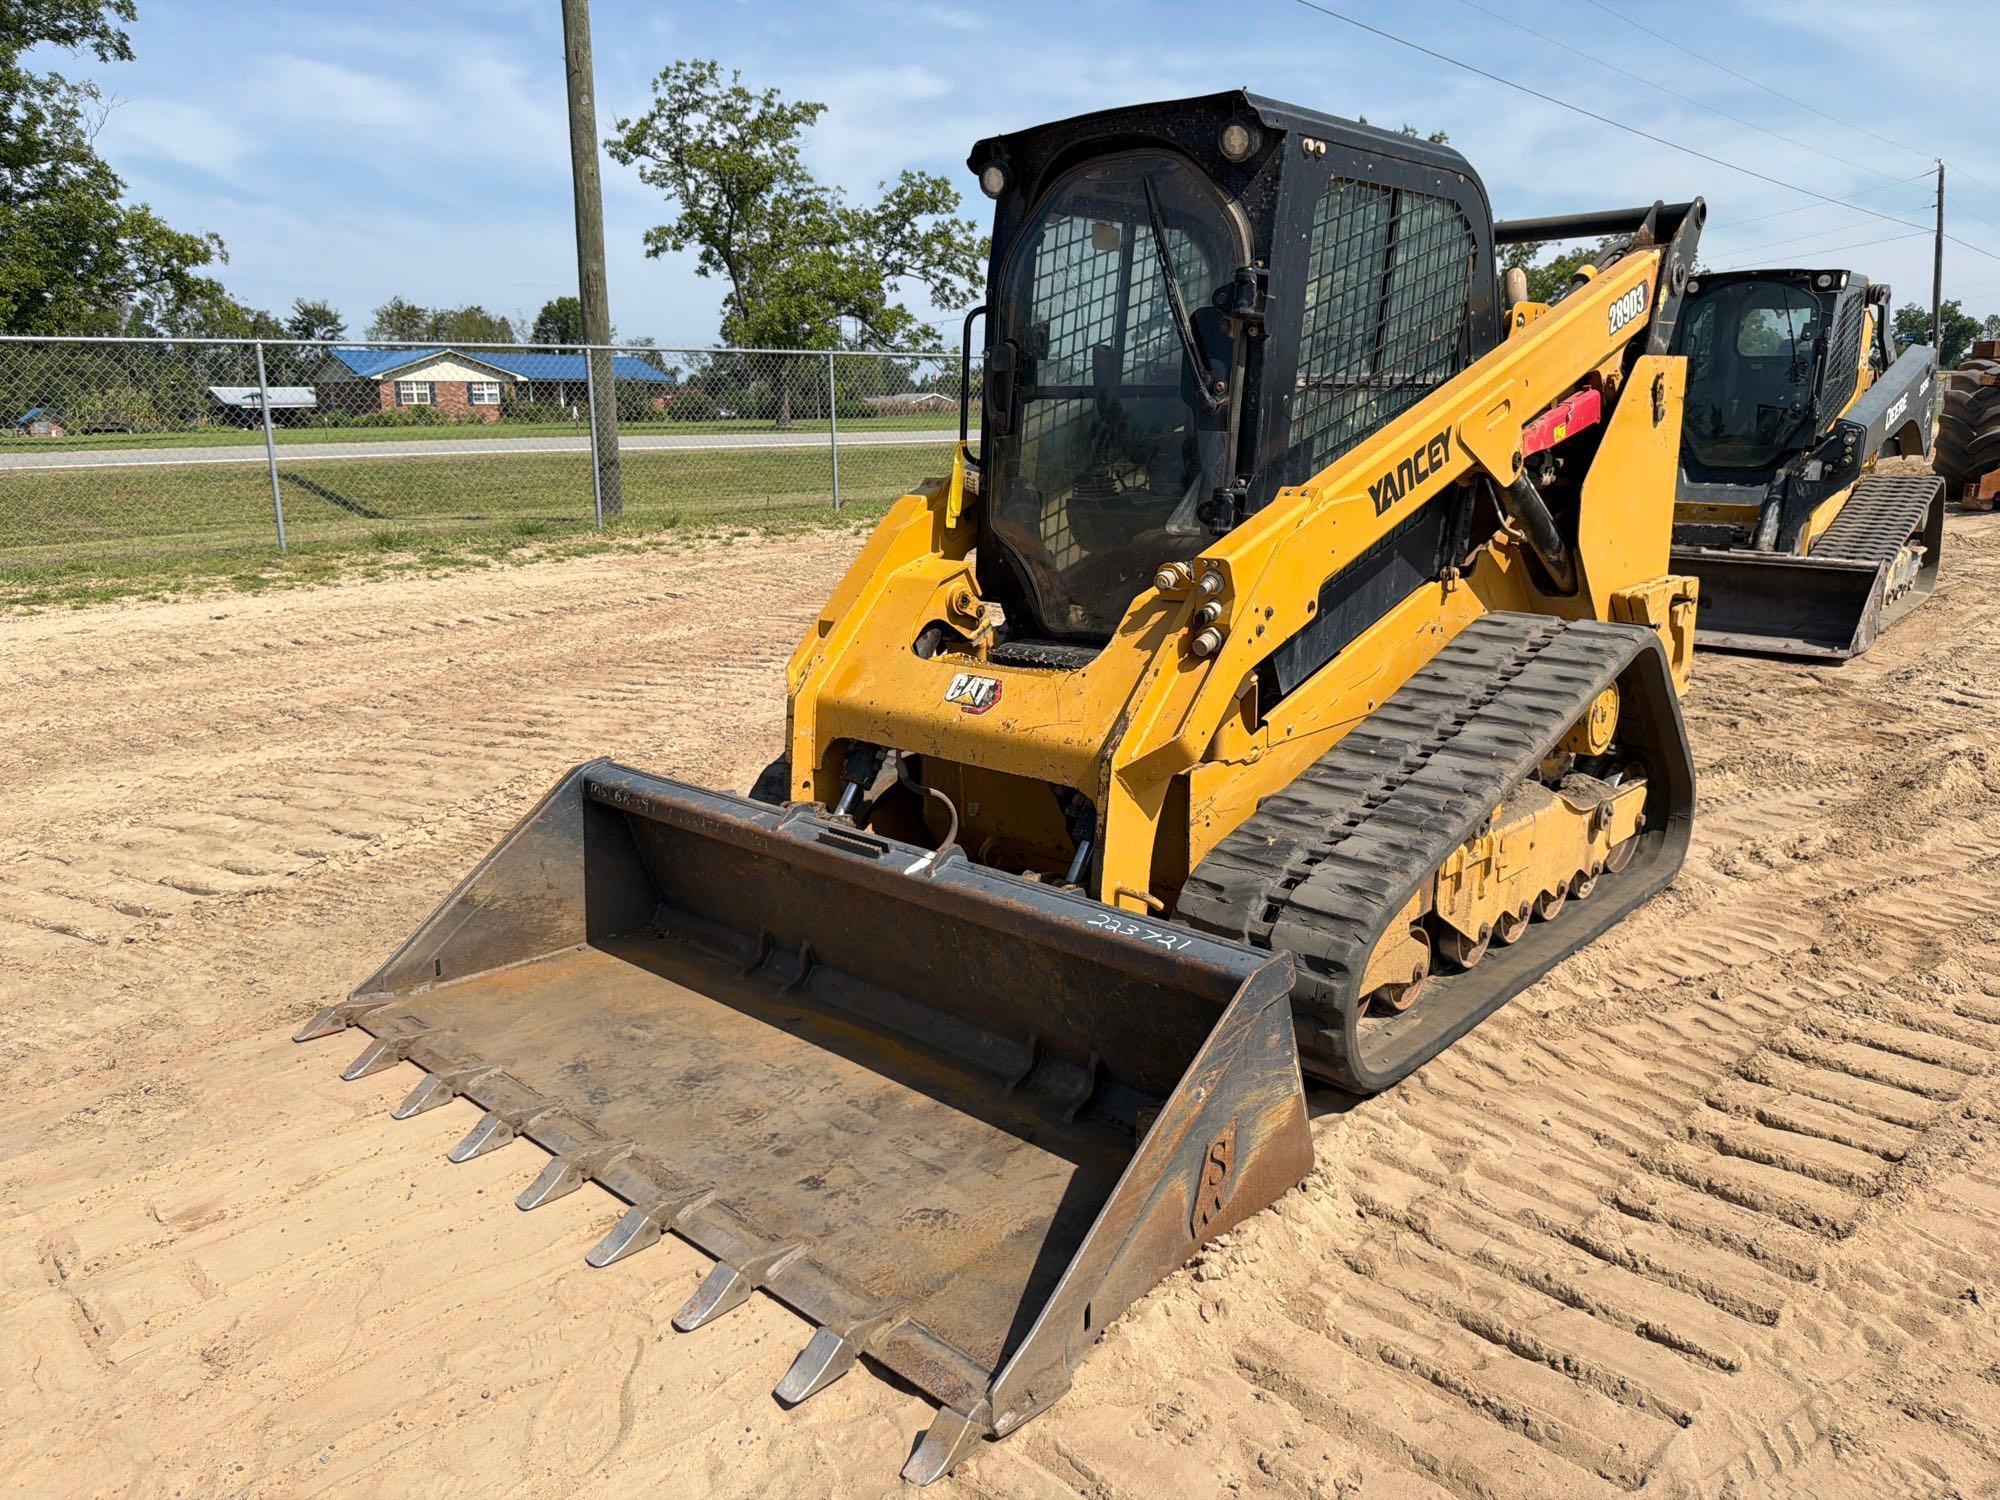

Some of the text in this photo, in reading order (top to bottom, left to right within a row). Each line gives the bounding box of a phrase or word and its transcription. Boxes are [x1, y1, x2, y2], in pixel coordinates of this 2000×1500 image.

[1608, 282, 1645, 336] 289D3
[1367, 424, 1452, 518] YANCEY
[944, 673, 996, 706] CAT
[1087, 914, 1192, 950] 223721
